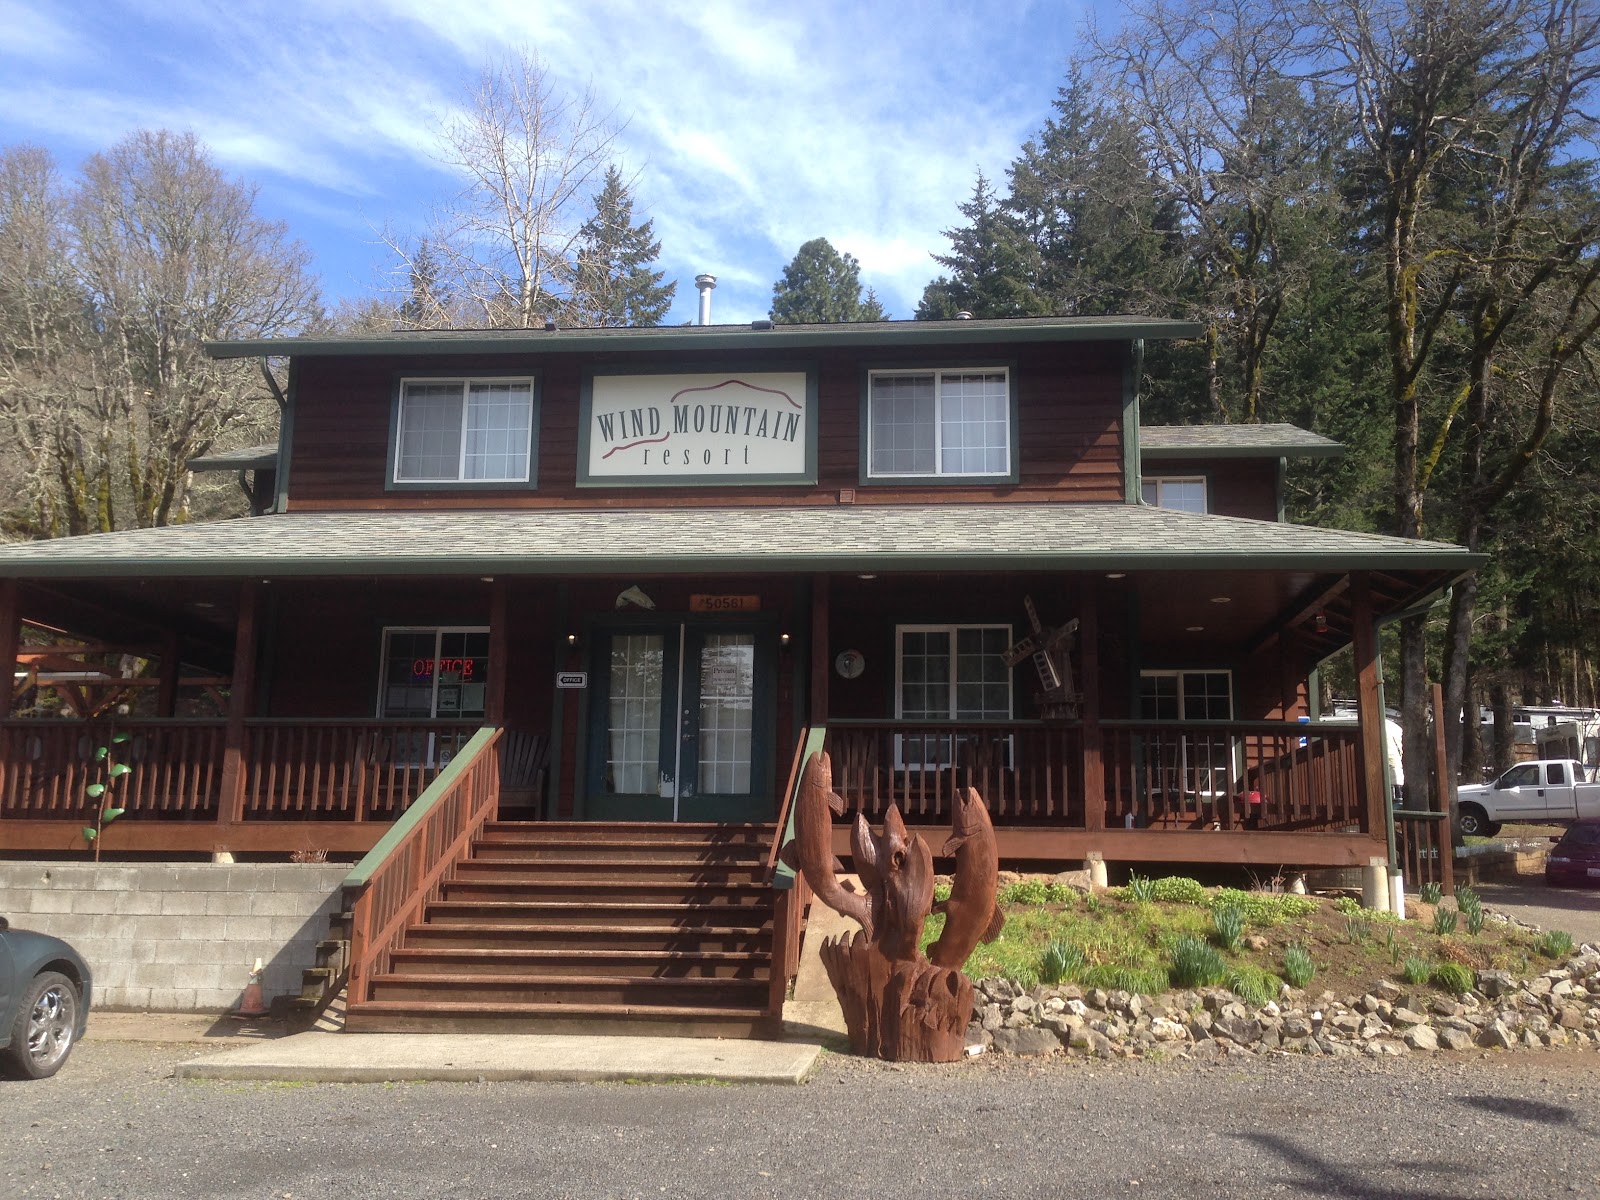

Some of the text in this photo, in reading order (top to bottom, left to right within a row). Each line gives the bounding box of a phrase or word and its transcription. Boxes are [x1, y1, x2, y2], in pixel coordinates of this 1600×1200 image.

[597, 404, 801, 443] WIND MOUNTAIN
[643, 444, 749, 465] resort
